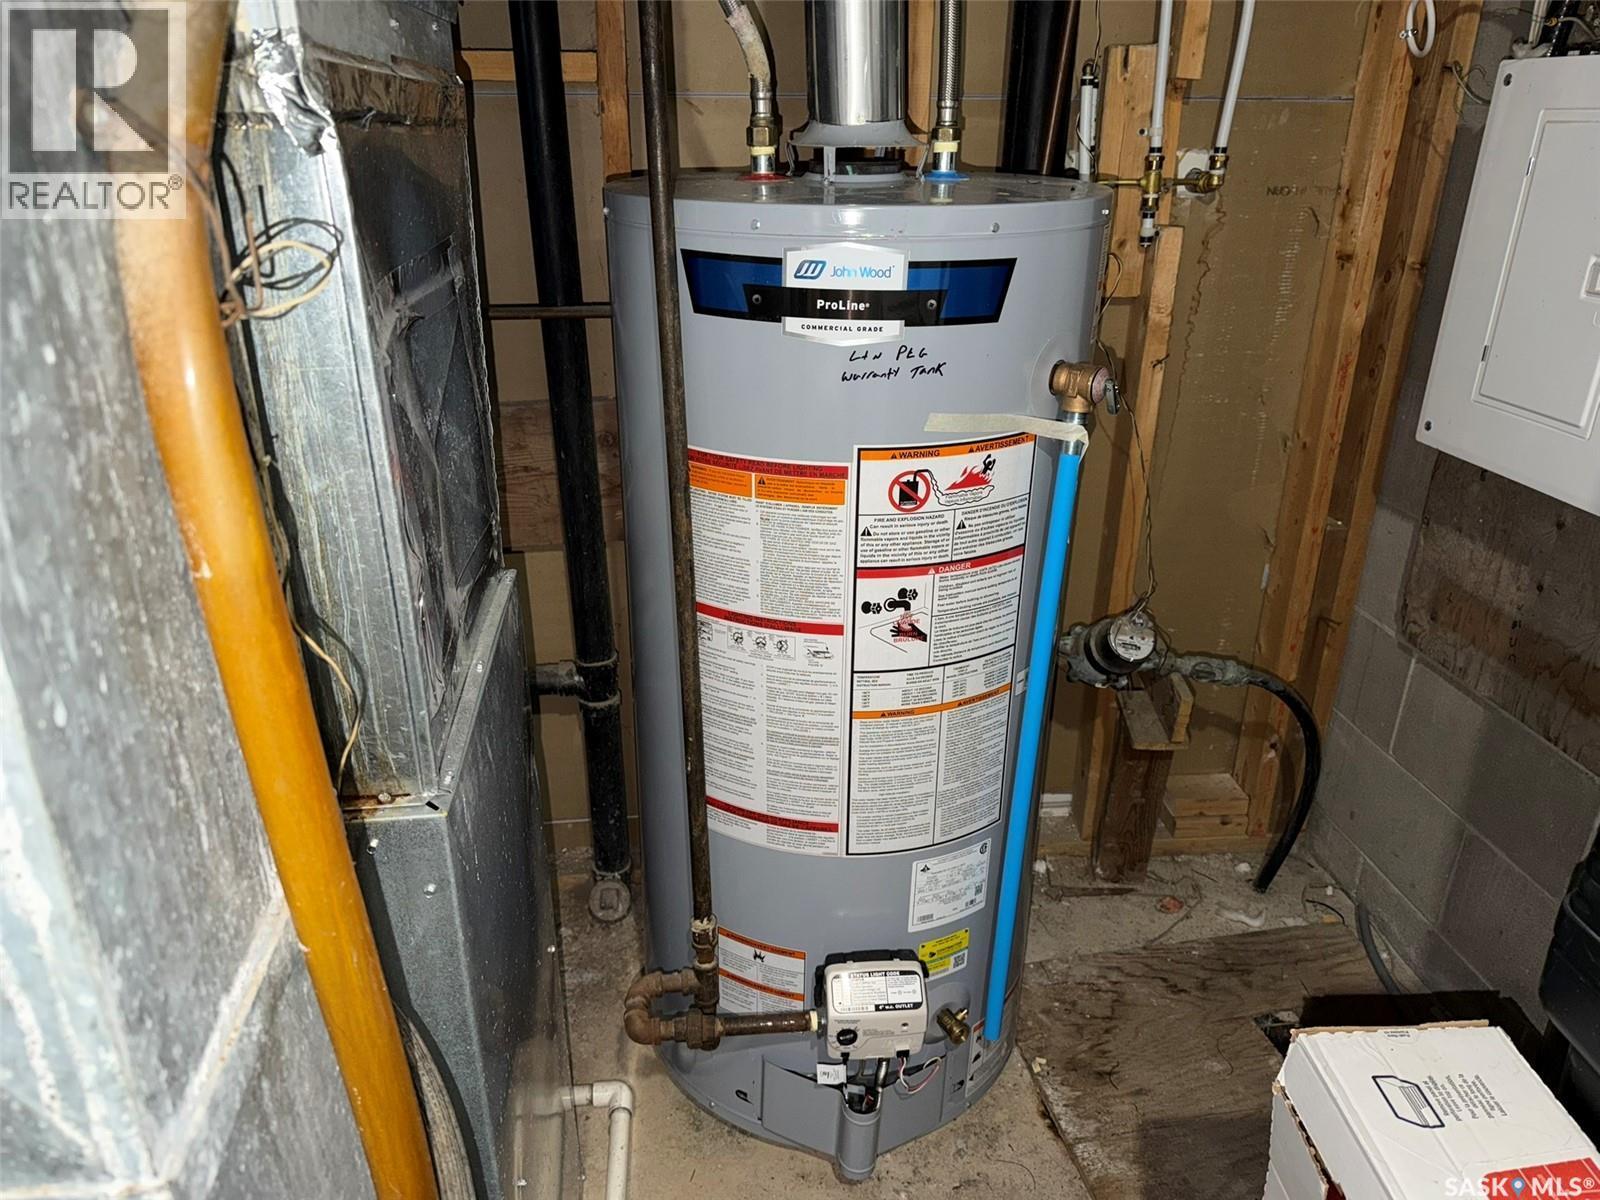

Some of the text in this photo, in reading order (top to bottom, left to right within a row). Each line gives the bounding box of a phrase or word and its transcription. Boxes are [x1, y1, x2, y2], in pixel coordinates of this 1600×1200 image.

[831, 266, 857, 278] John
[801, 324, 852, 332] COMMERCIAL
[975, 436, 1029, 453] AVERTISSEMENT
[899, 449, 940, 459] WARNING
[938, 562, 971, 573] DANGER
